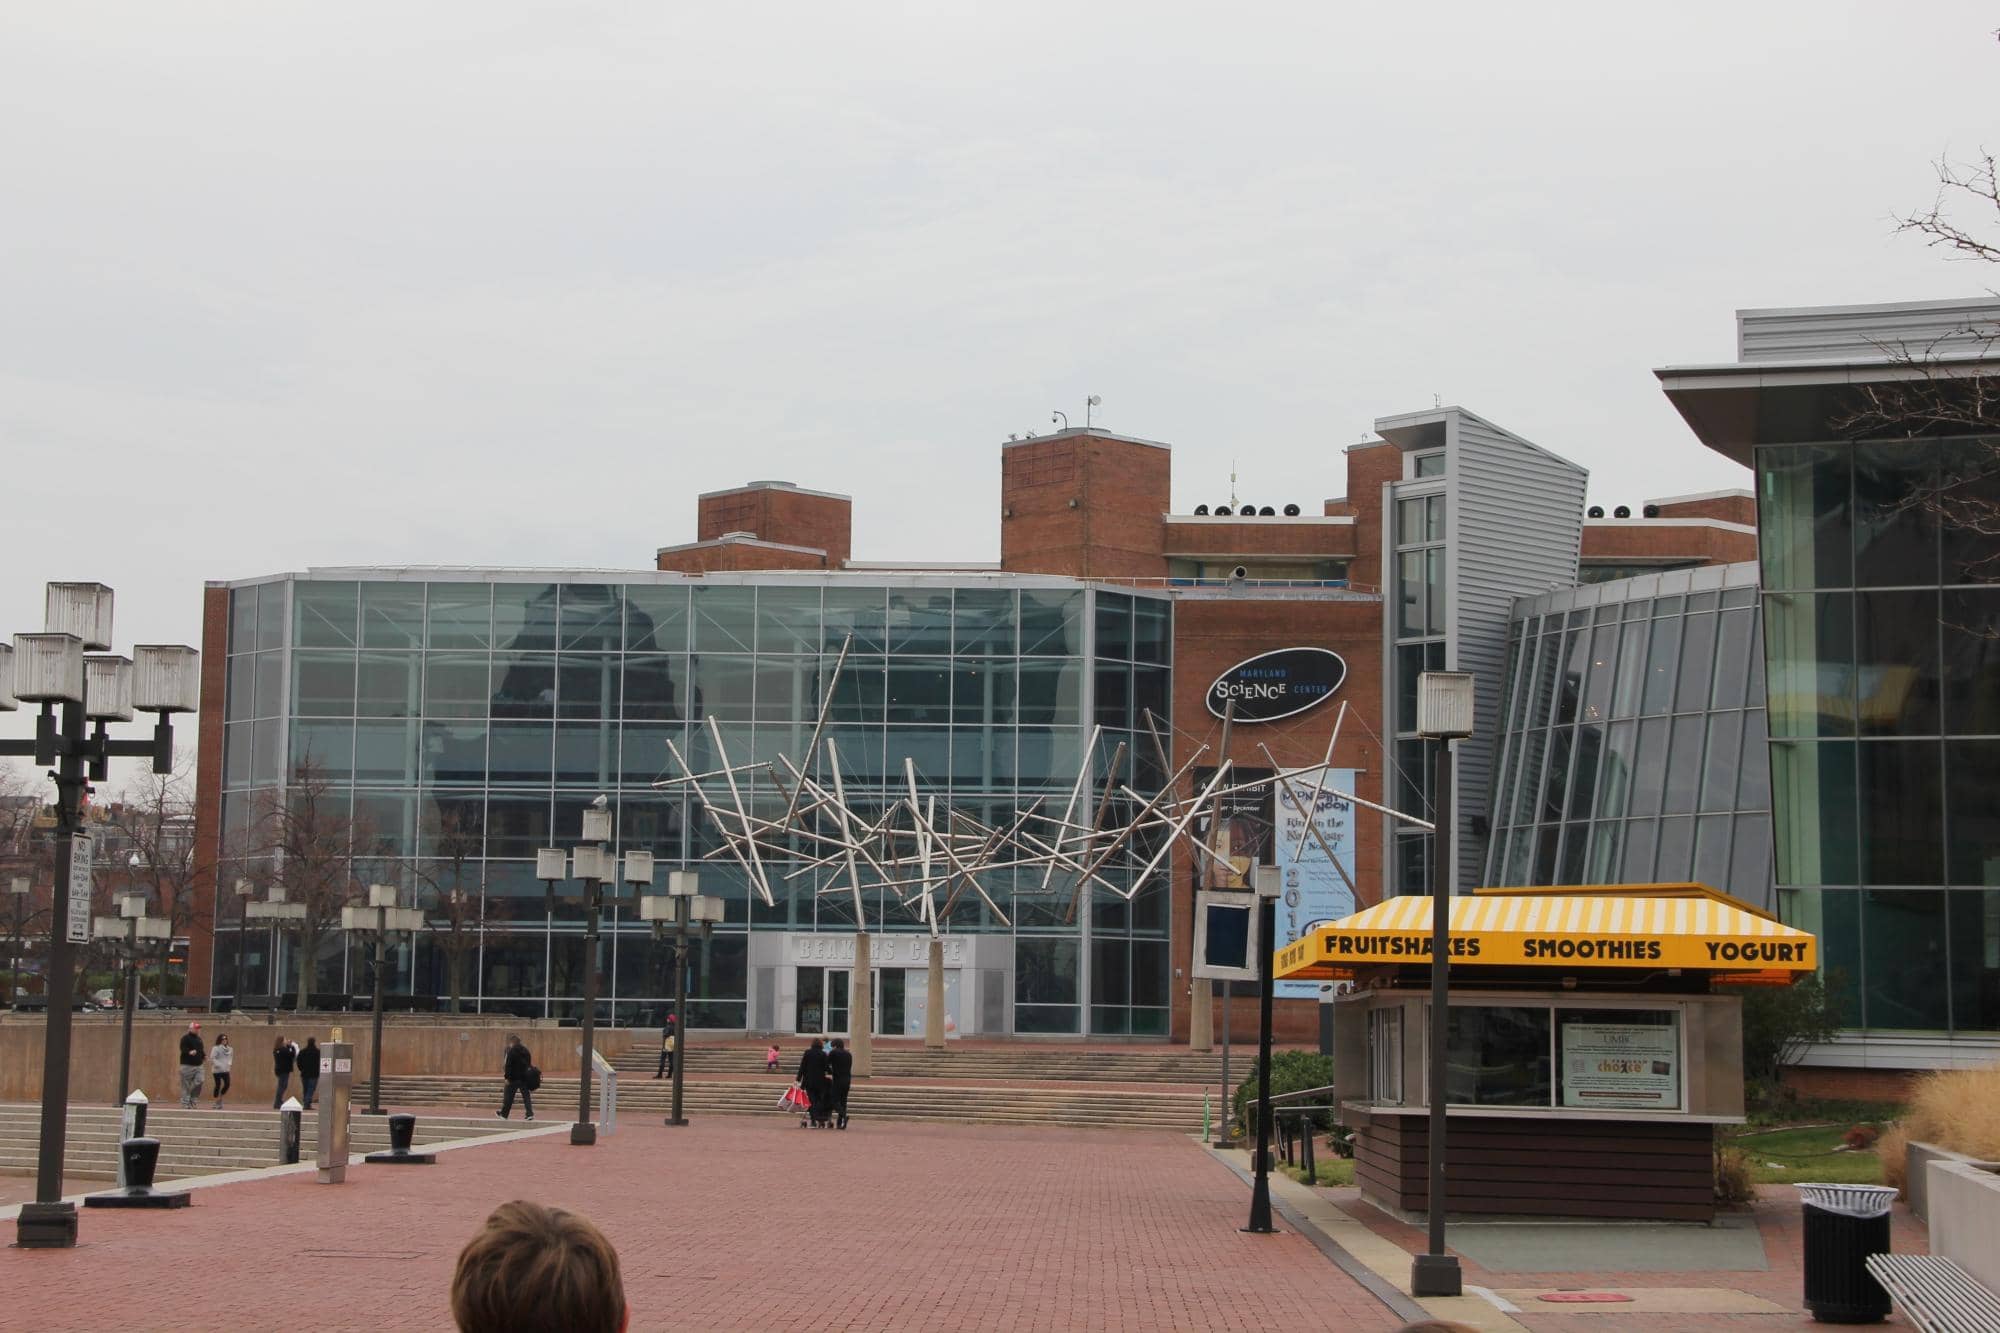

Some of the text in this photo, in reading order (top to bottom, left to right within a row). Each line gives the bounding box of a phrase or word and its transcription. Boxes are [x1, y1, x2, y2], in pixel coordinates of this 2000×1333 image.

[1240, 668, 1287, 678] MARYLAND
[1294, 685, 1328, 694] CENTER
[1287, 817, 1306, 828] Rin
[800, 939, 961, 961] BEAKRS CFE
[1325, 935, 1480, 956] FRUITSHAES
[1523, 939, 1661, 960] SMOOTHIES
[1705, 942, 1808, 962] YOGURT
